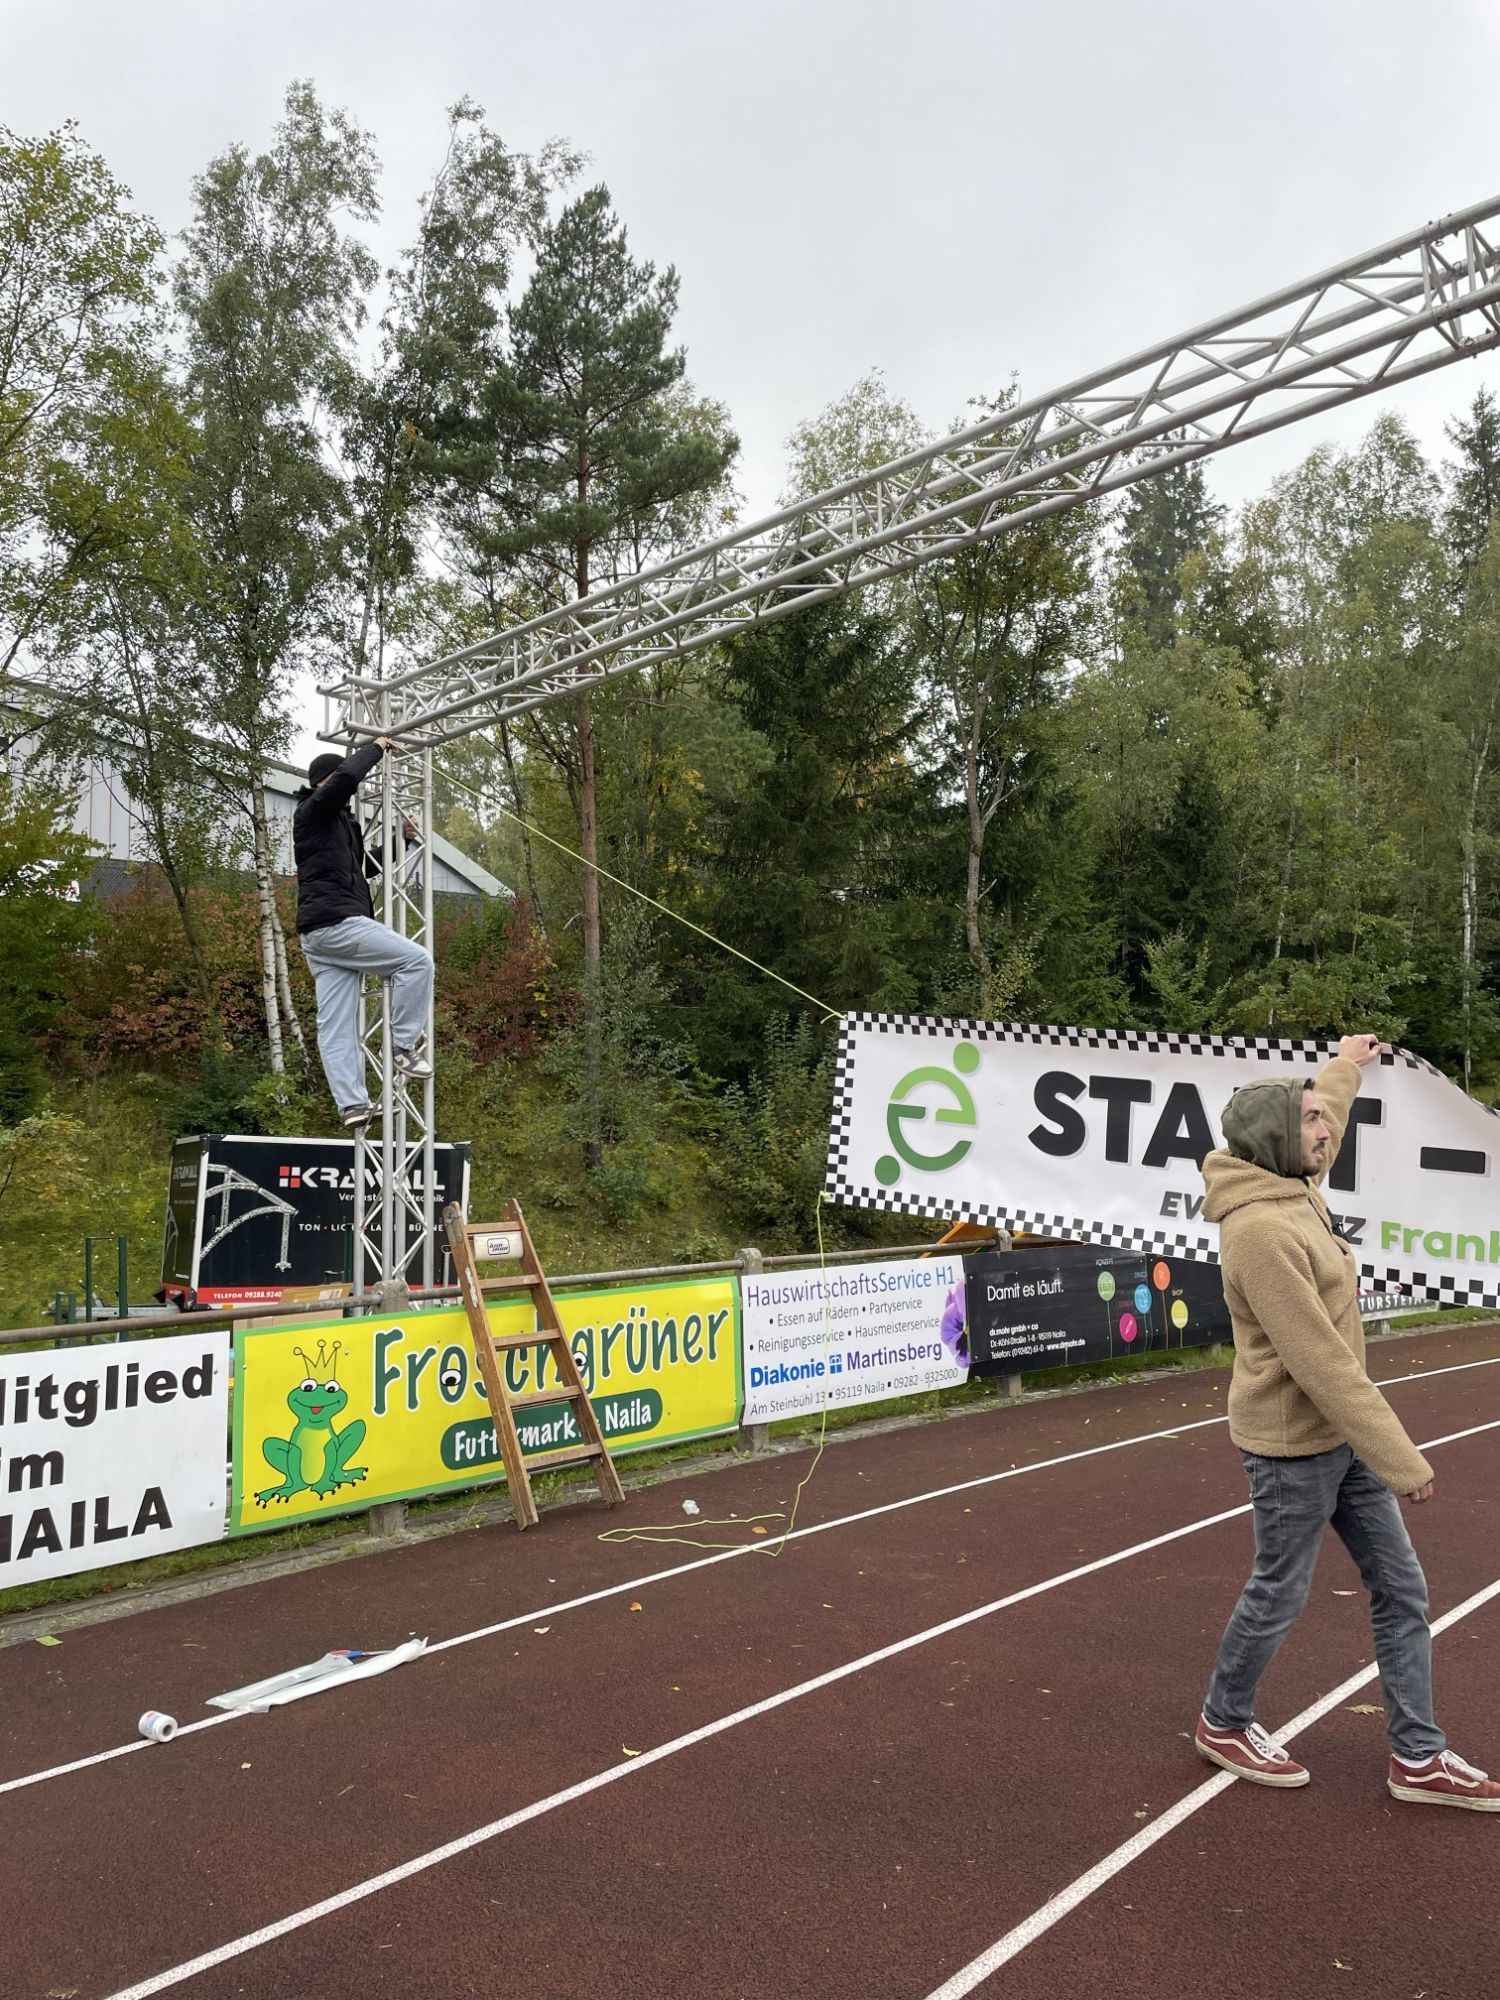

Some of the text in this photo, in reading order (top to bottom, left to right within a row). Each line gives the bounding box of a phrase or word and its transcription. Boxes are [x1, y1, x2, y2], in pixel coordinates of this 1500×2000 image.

[1028, 1070, 1382, 1192] STAT
[299, 1223, 321, 1232] TON
[408, 1222, 444, 1232] BÜNE
[747, 1266, 955, 1308] HauswirtschaftsService H1
[987, 1279, 1064, 1301] Damit es läuft.
[1359, 1295, 1428, 1312] TURSTEIN
[777, 1298, 923, 1327] Essen auf Rädern Partyservice
[1010, 1323, 1027, 1335] gmbh
[1031, 1323, 1039, 1331] co
[1052, 1329, 1067, 1338] Naila
[758, 1317, 940, 1353] Reinigungsservice Hausmeisterservice
[750, 1343, 942, 1388] Diakonie Martinsberg
[0, 1353, 214, 1428] itglied
[750, 1403, 767, 1416] Am
[770, 1396, 813, 1412] Steinbühl
[815, 1391, 826, 1404] 13
[835, 1384, 862, 1400] 95119
[864, 1382, 885, 1395] Naila
[893, 1375, 918, 1389] 09282
[924, 1367, 959, 1384] 9325000
[454, 1398, 652, 1462] Futtmark Naila
[0, 1447, 65, 1493] m
[0, 1486, 173, 1564] AILA
